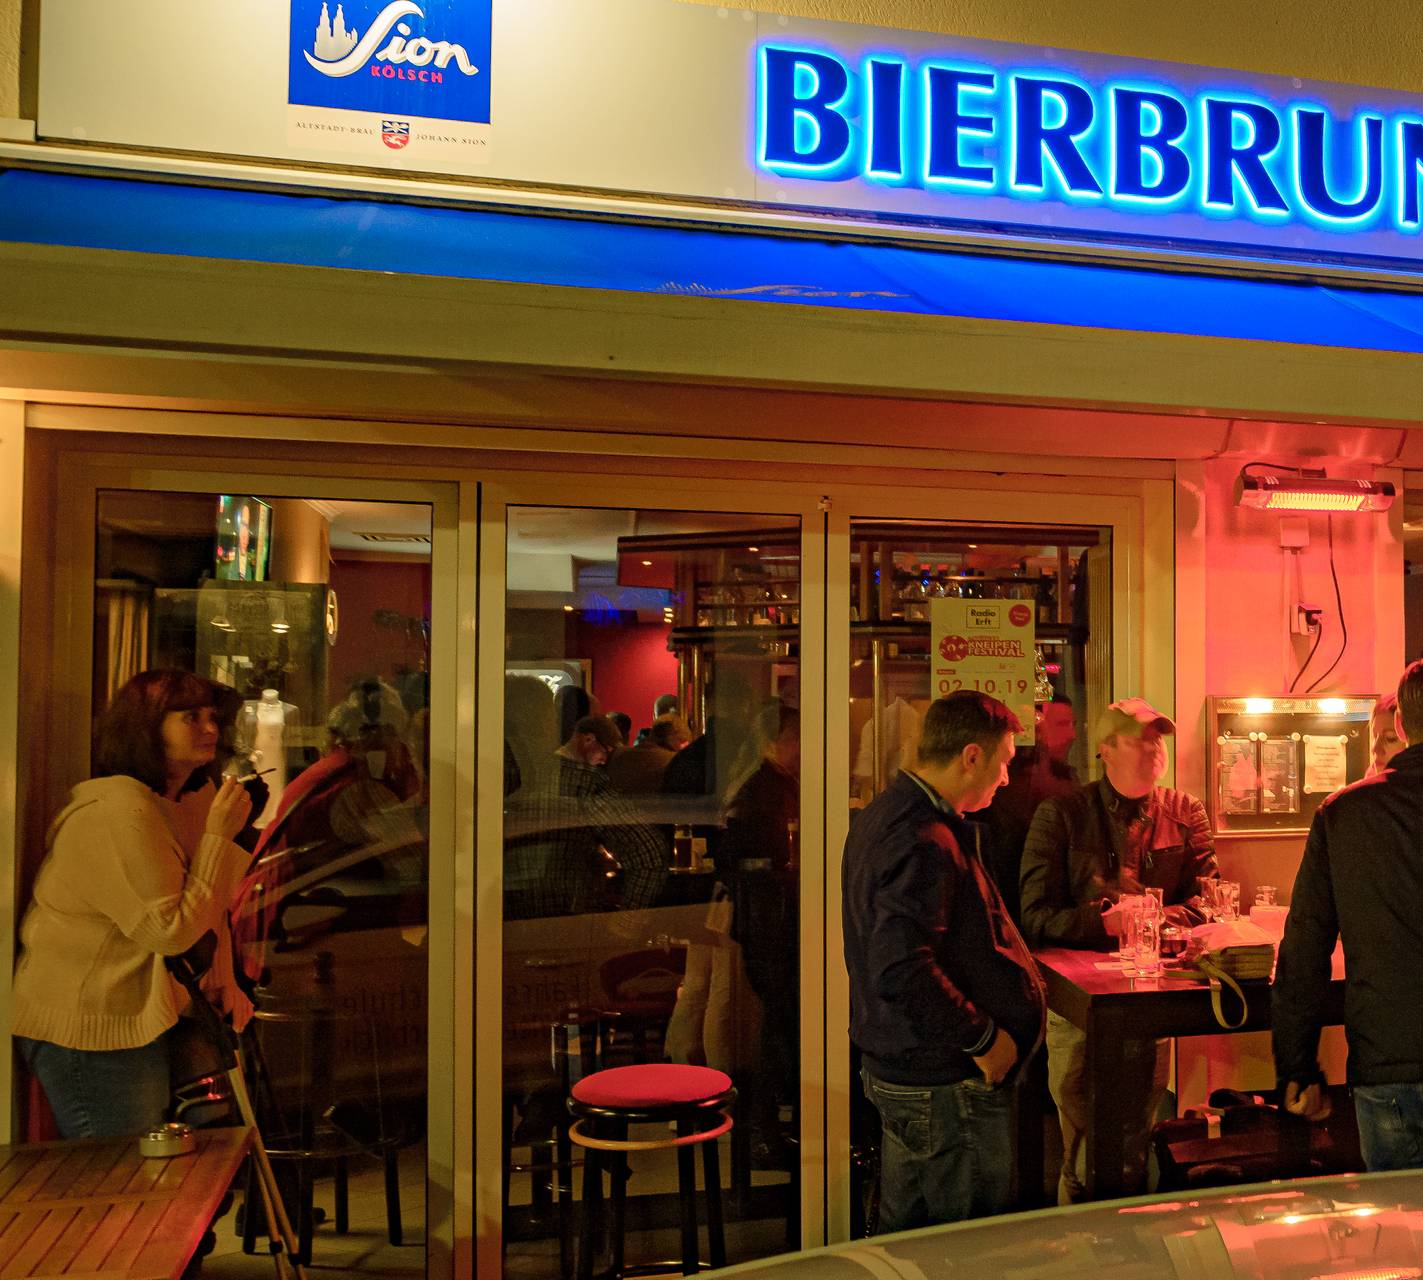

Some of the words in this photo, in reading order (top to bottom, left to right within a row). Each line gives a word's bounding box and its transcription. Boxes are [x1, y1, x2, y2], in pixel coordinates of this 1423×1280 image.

[303, 0, 479, 77] Sion
[370, 64, 443, 84] KÖLSCH
[461, 138, 487, 147] SION
[970, 608, 996, 617] Radio
[975, 618, 991, 626] Erft
[967, 640, 1021, 649] KNEIPEN
[967, 648, 1025, 657] FESTIVAL
